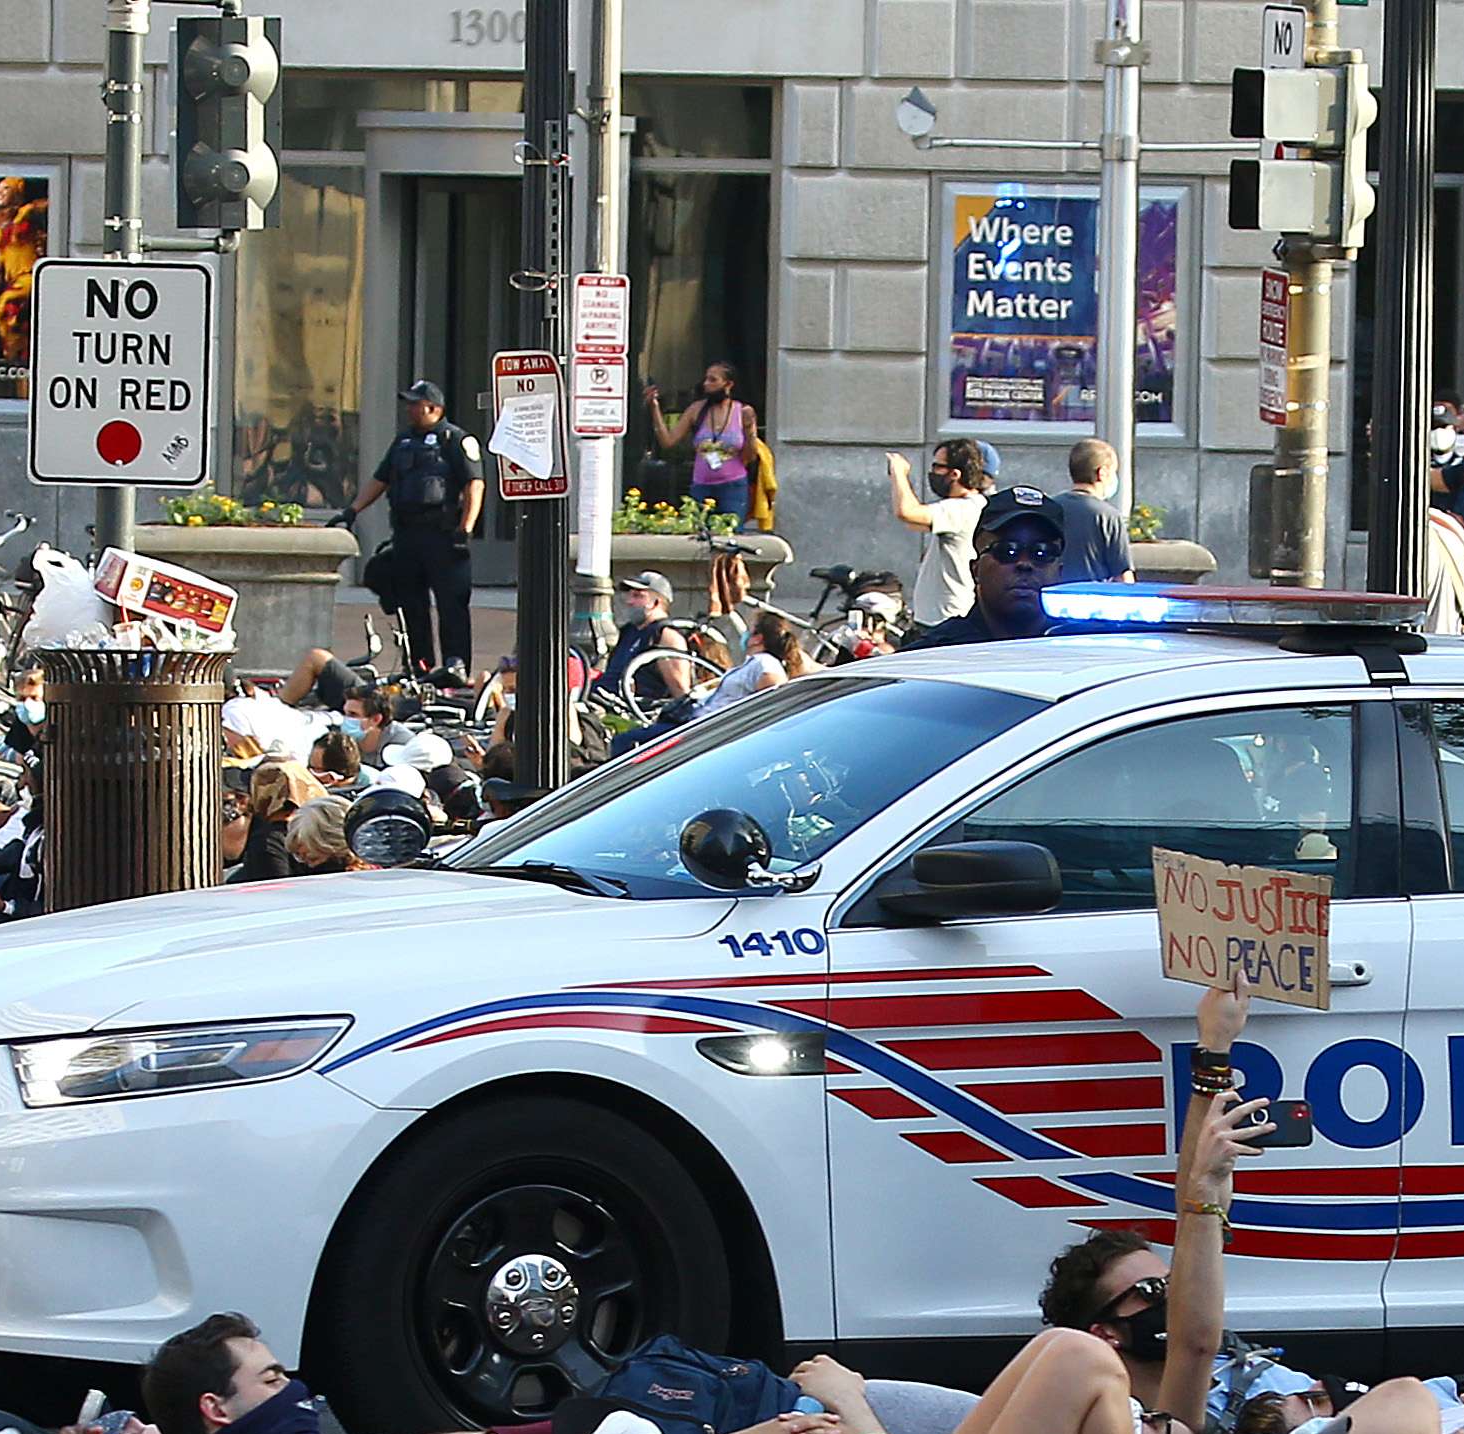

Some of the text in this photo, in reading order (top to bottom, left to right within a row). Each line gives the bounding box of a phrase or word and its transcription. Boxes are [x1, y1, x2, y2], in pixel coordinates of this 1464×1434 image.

[1274, 20, 1292, 55] NO
[968, 215, 1074, 245] Where
[967, 253, 1073, 282] Events
[86, 278, 158, 320] NO
[966, 290, 1073, 319] Matter
[72, 331, 171, 366] TURN
[501, 357, 550, 371] TOW AWAY
[49, 376, 191, 411] ON RED
[516, 379, 535, 393] NO
[1163, 867, 1332, 938] NO JUSTICE
[718, 928, 825, 958] 1410
[1168, 931, 1315, 993] NO PEACE
